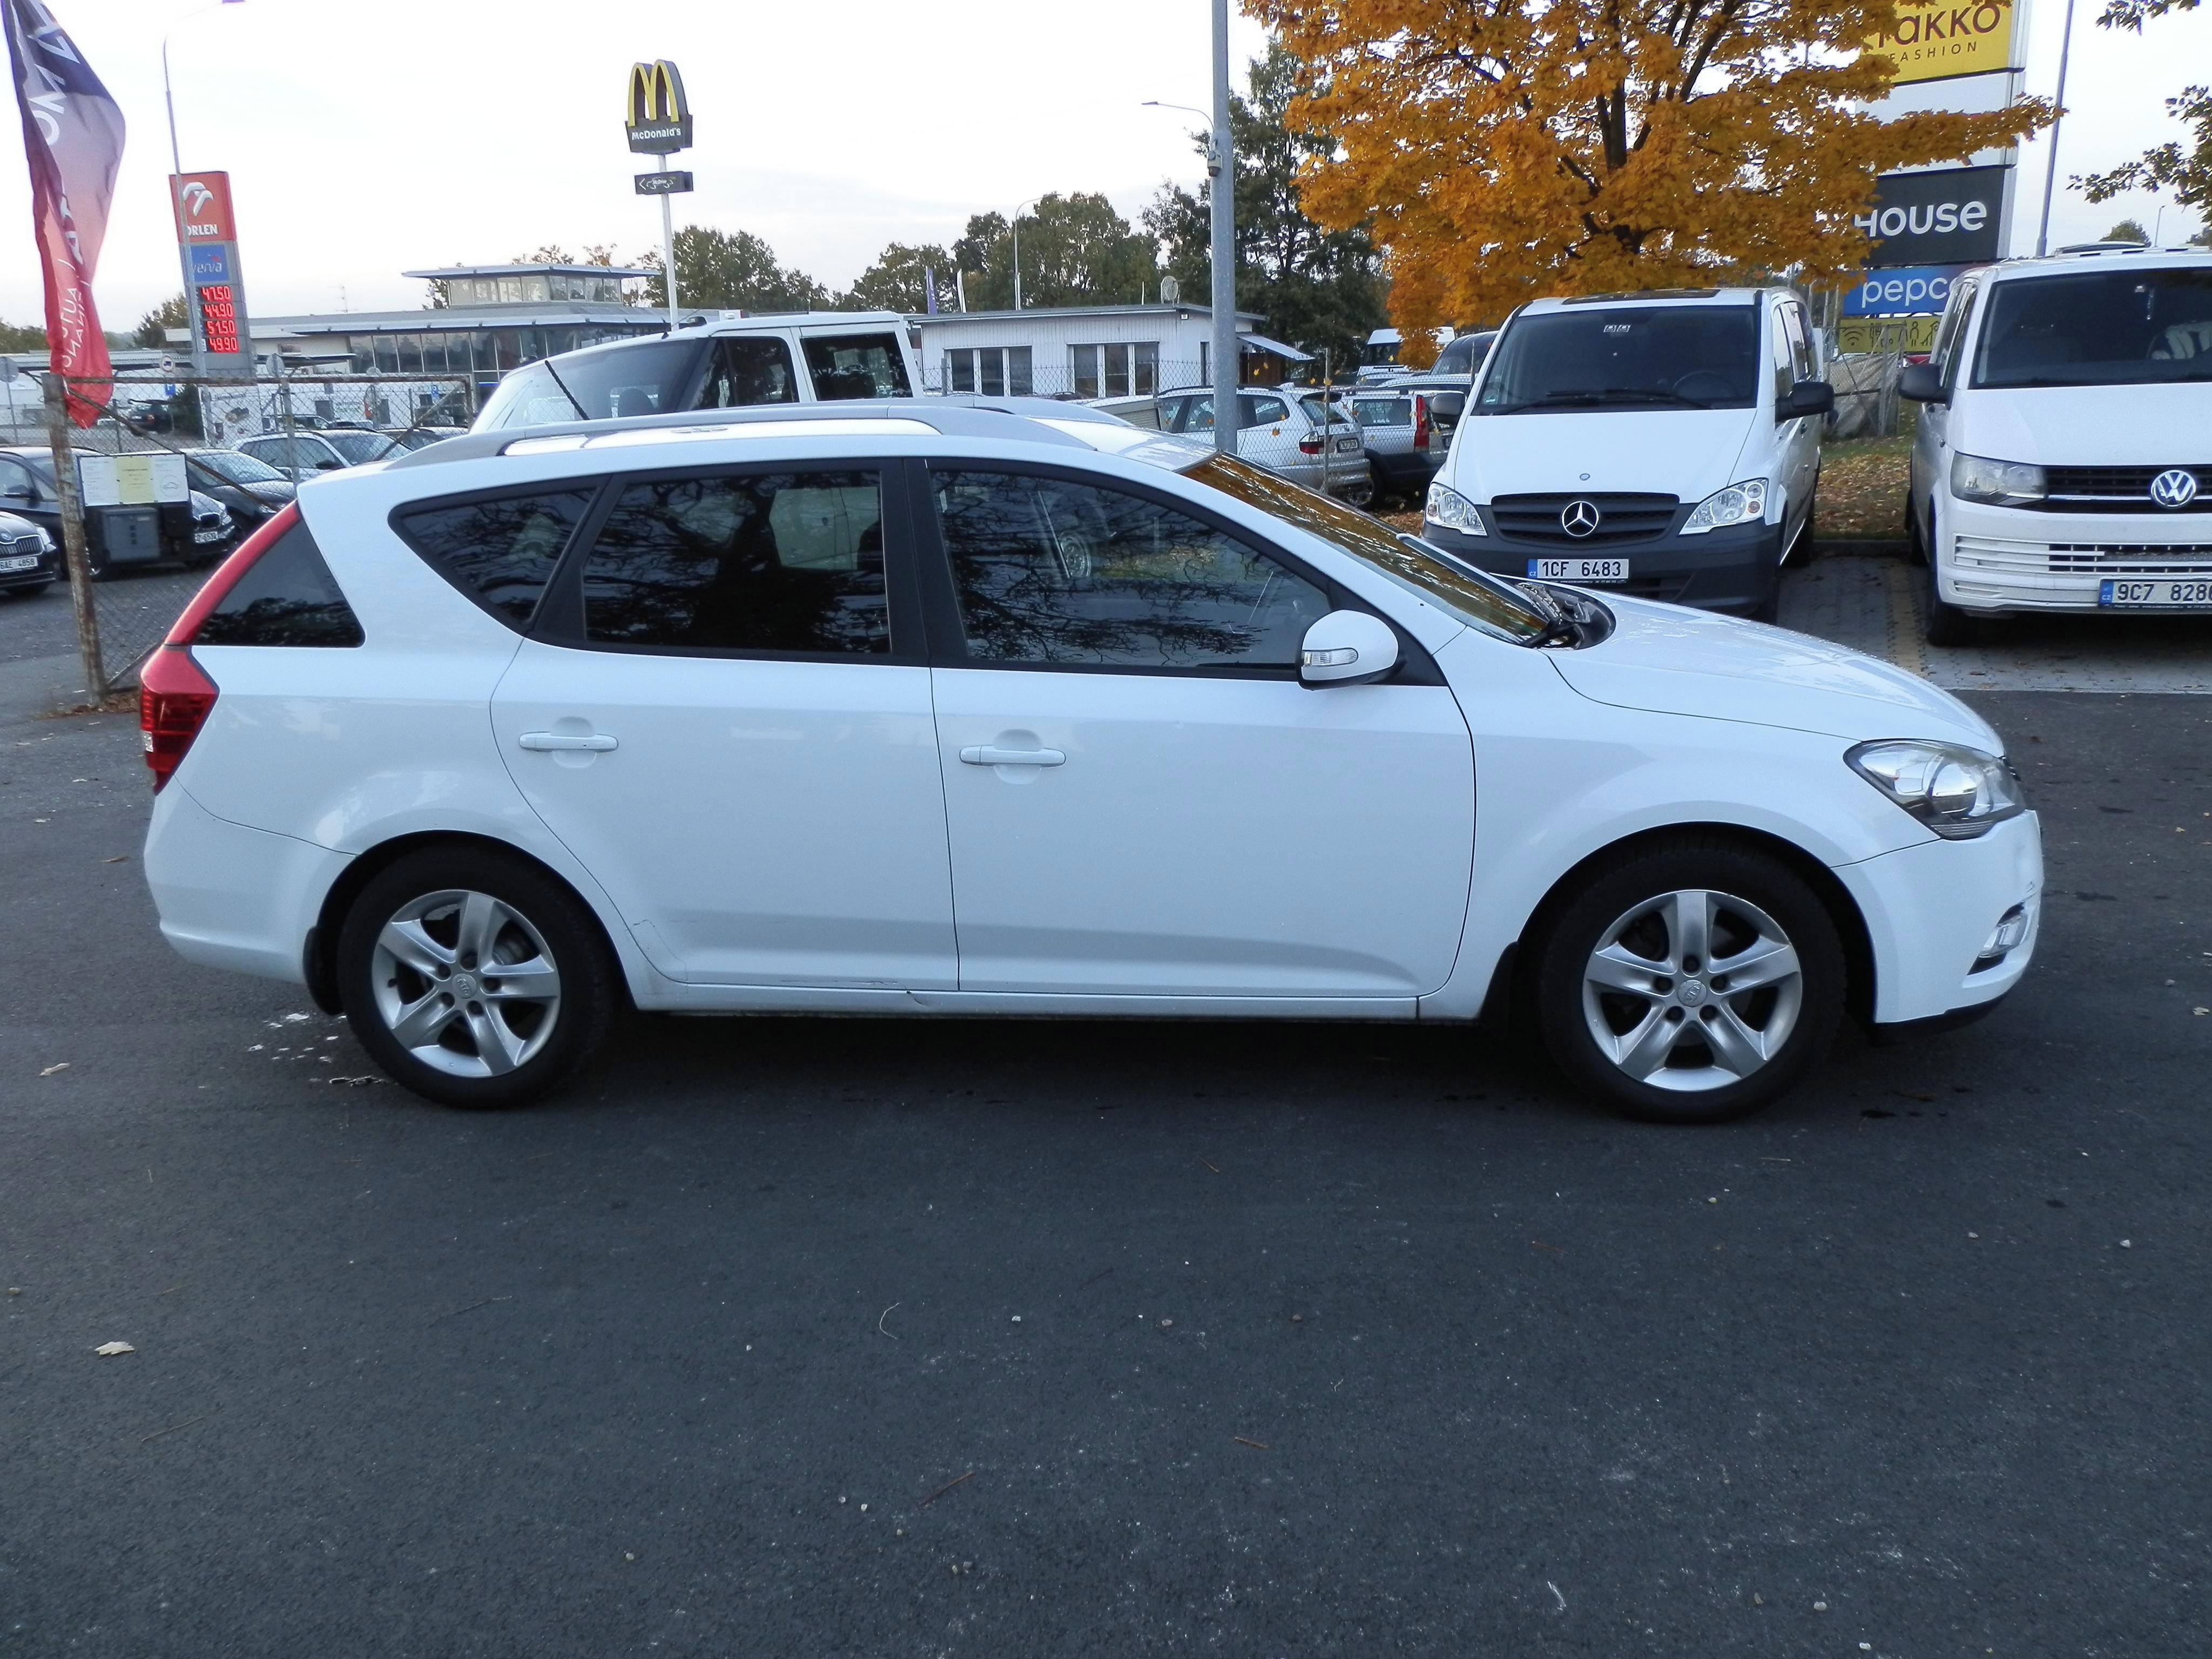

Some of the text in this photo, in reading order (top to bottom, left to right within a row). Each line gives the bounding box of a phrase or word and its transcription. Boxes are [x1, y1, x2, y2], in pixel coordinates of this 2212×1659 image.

[1889, 41, 1977, 62] FASHION
[631, 127, 682, 140] McDonald's
[1542, 561, 1569, 577] 1CF
[1581, 561, 1621, 577] 6483
[2117, 583, 2155, 601] 9C7
